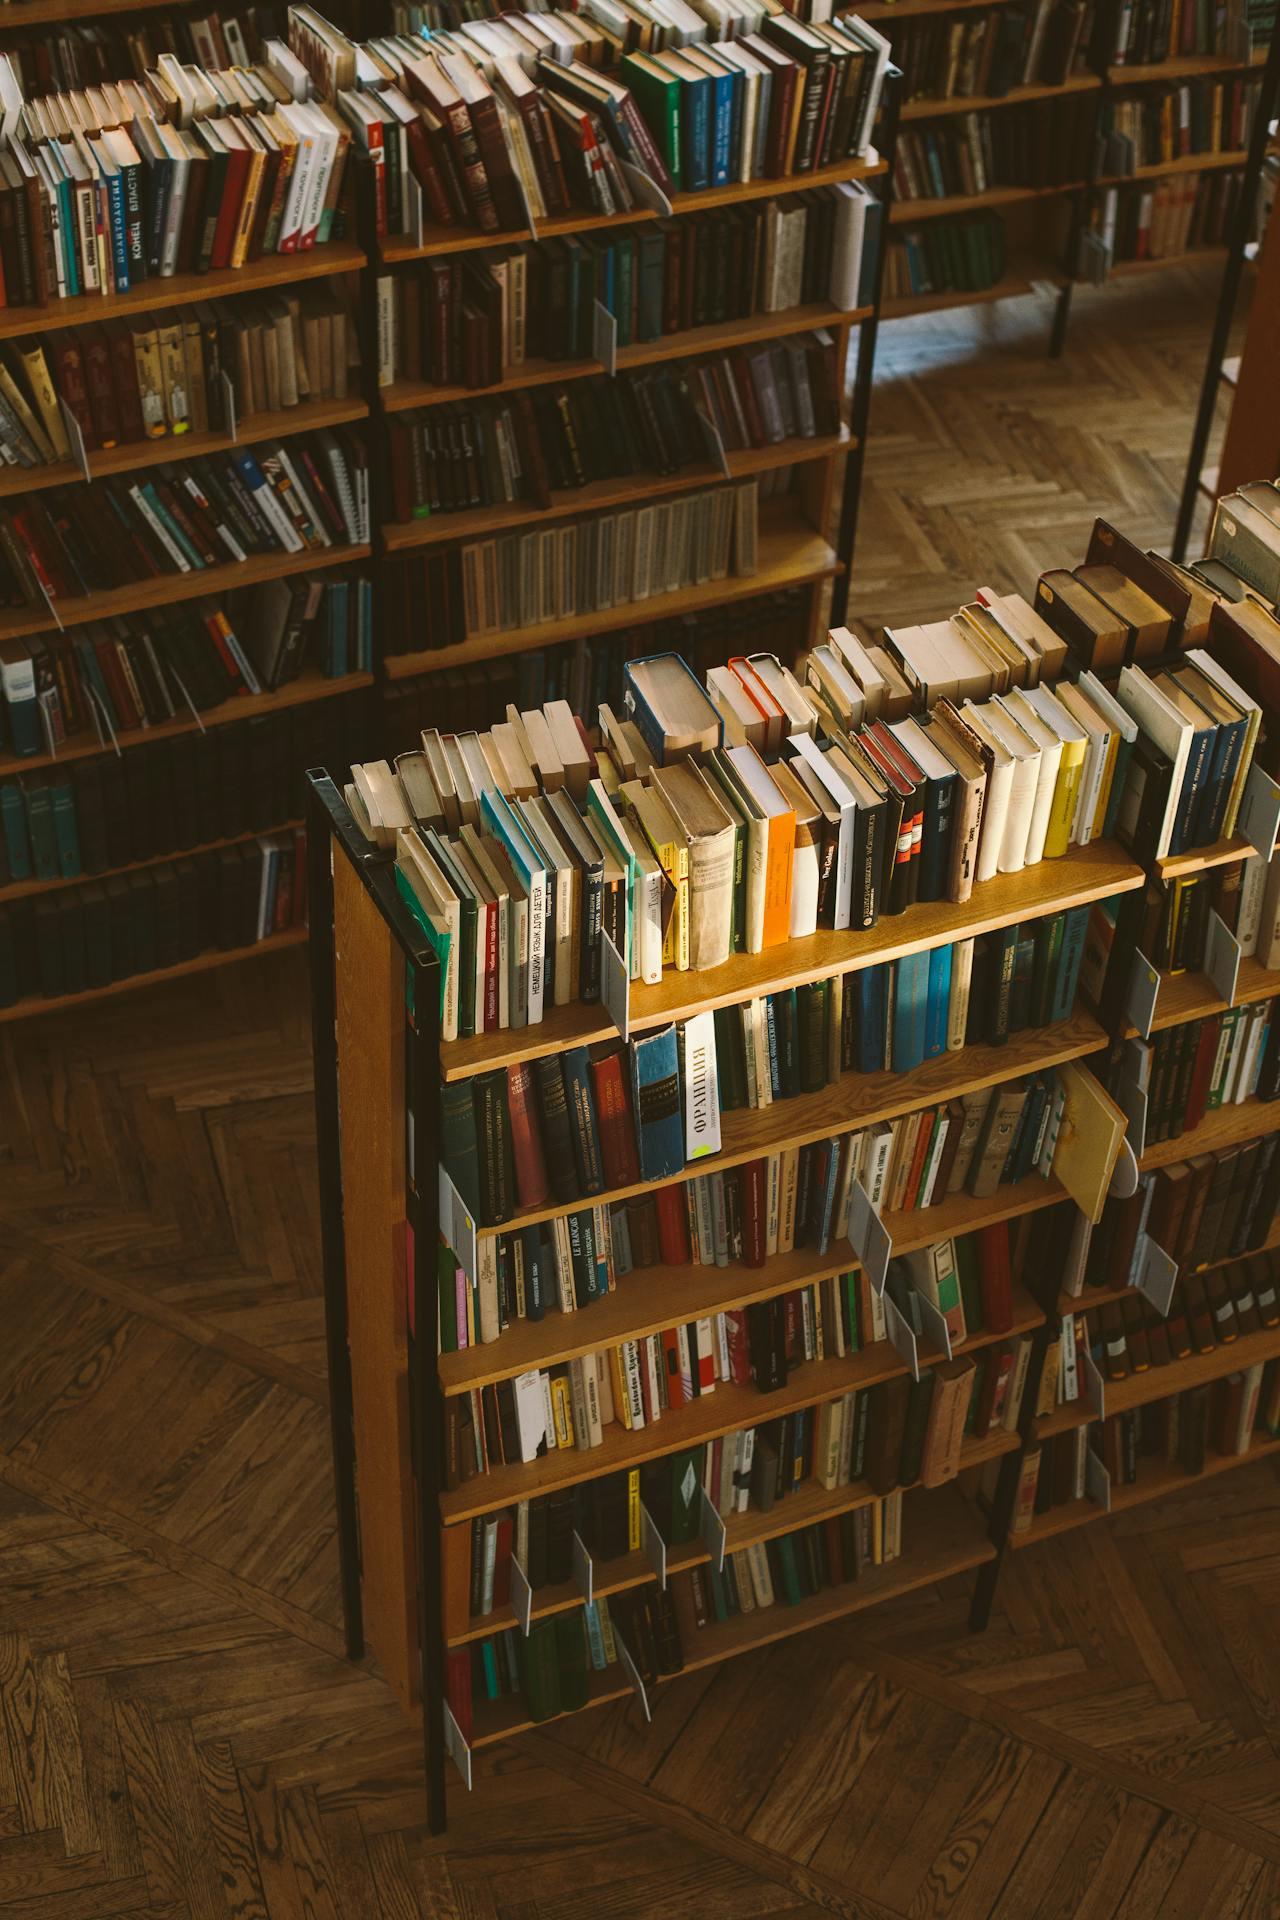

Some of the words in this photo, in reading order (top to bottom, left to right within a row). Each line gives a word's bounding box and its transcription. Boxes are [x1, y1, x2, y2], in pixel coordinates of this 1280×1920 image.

[128, 168, 139, 212] ВЛАСТИ
[112, 180, 125, 263] ПОЛИТОЛОГИЯ
[131, 221, 142, 260] КОНЕЦ
[825, 845, 835, 866] Golem
[822, 866, 831, 879] Der
[532, 887, 542, 911] ДЕТЕЙ
[532, 913, 542, 930] ДЛЯ
[532, 932, 542, 952] ЯЗЫК
[532, 954, 542, 995] НЕМЕЦКИЙ
[487, 991, 496, 1019] Немецкий
[693, 1046, 707, 1133] ФРАНЦИЯ
[874, 1173, 883, 1186] LUPIN
[569, 1217, 580, 1246] FRANÇAIS
[584, 1228, 594, 1257] française
[573, 1247, 581, 1256] LE
[587, 1257, 596, 1292] Grammaire
[627, 1342, 637, 1370] Riquiqu
[631, 1376, 641, 1417] Roudoudou
